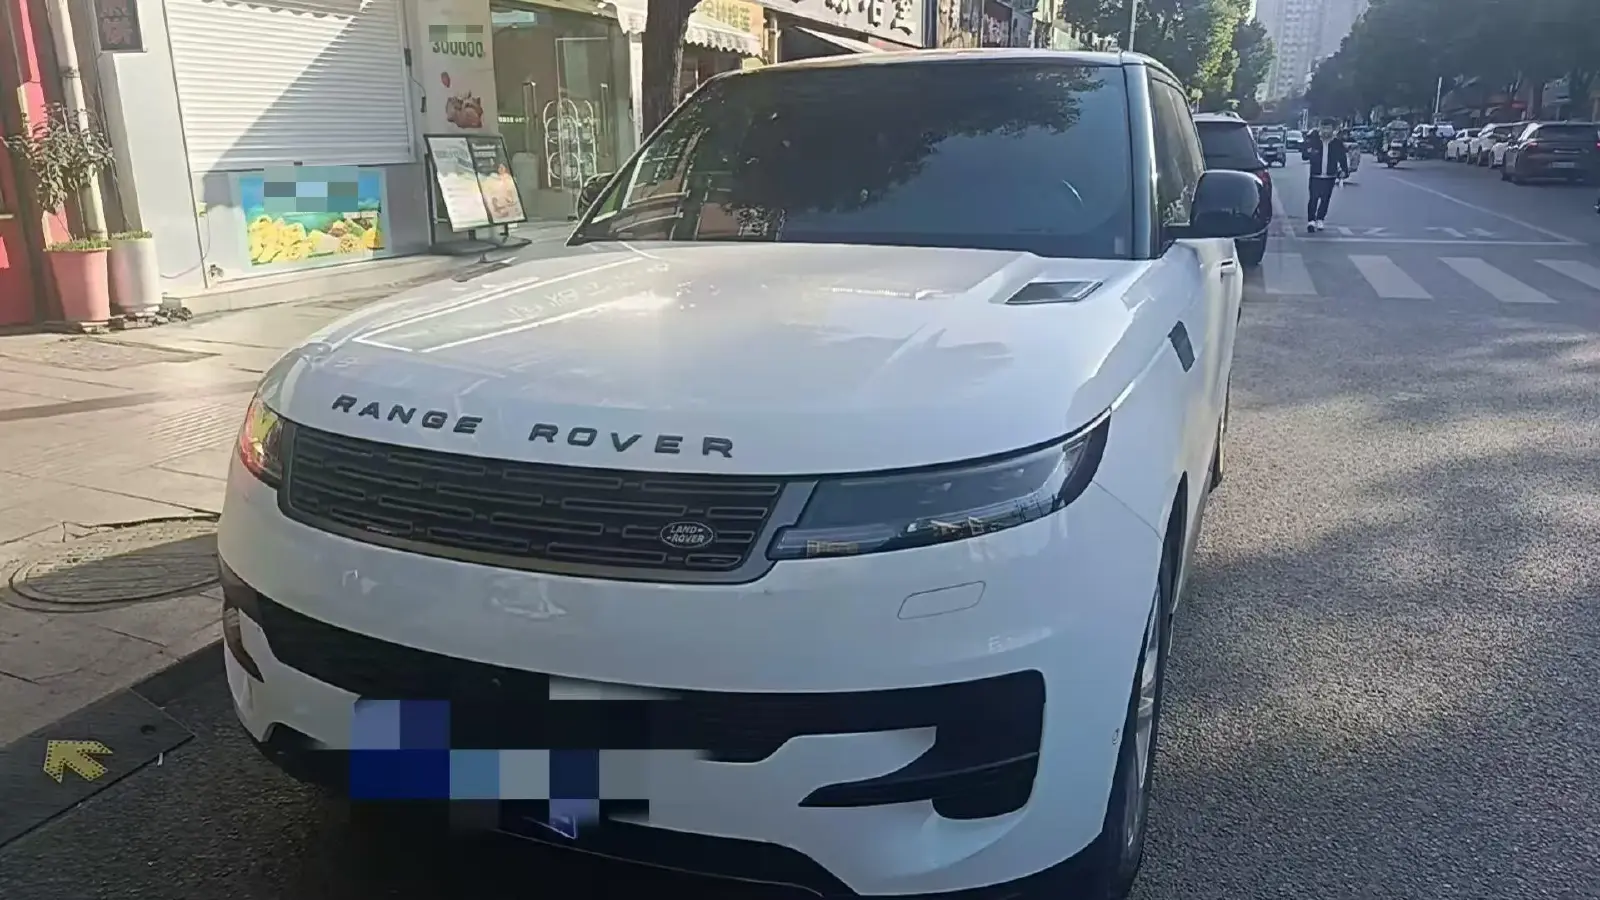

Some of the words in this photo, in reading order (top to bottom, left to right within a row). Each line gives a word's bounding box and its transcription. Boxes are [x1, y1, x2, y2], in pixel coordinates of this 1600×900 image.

[332, 394, 483, 434] RANGE
[528, 423, 733, 458] ROVER
[670, 525, 697, 534] LAND
[671, 534, 705, 543] ROVER
